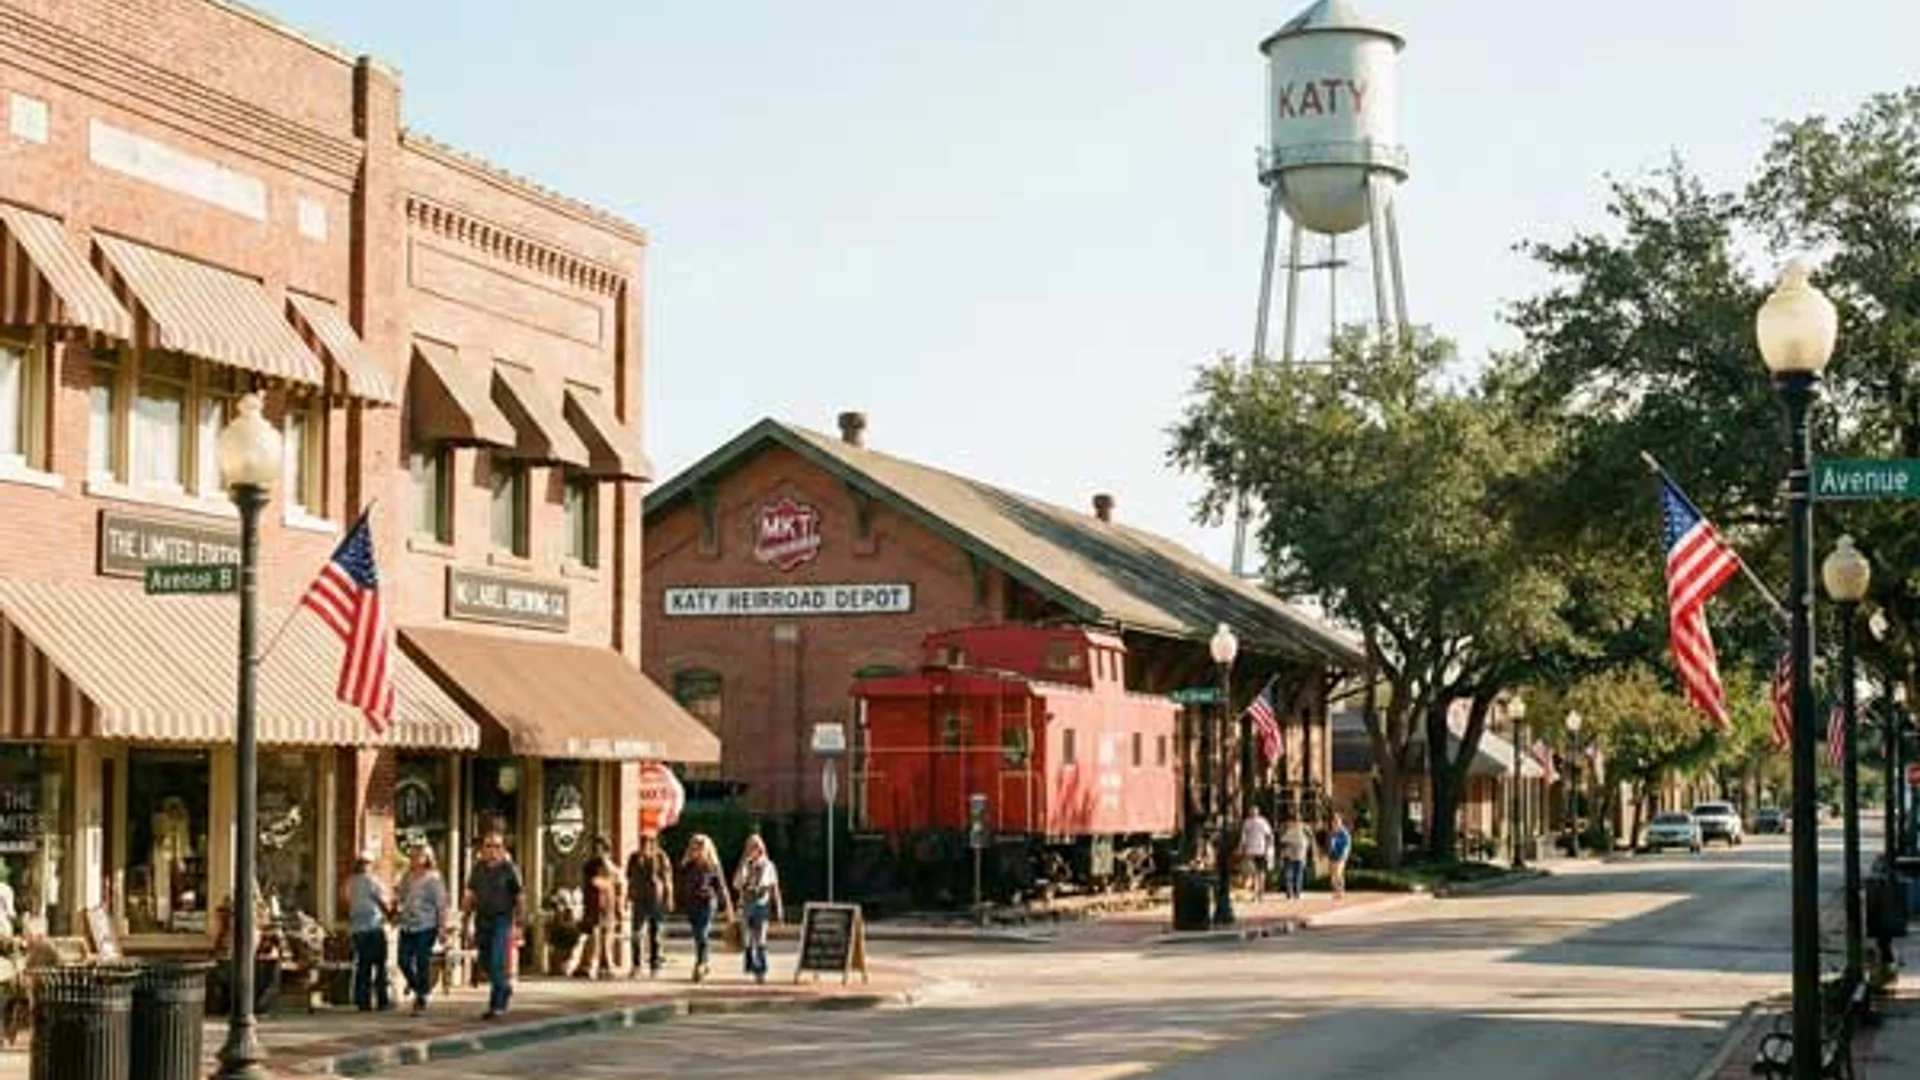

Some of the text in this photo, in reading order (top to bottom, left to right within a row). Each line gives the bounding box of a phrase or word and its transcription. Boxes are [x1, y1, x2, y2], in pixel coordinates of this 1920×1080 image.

[1278, 78, 1367, 119] KATY
[1820, 466, 1909, 493] Avenue
[763, 514, 811, 538] MKT
[108, 528, 137, 558] THE
[151, 567, 233, 590] Avenue B
[671, 588, 719, 611] KATY
[834, 587, 904, 609] DEPOT
